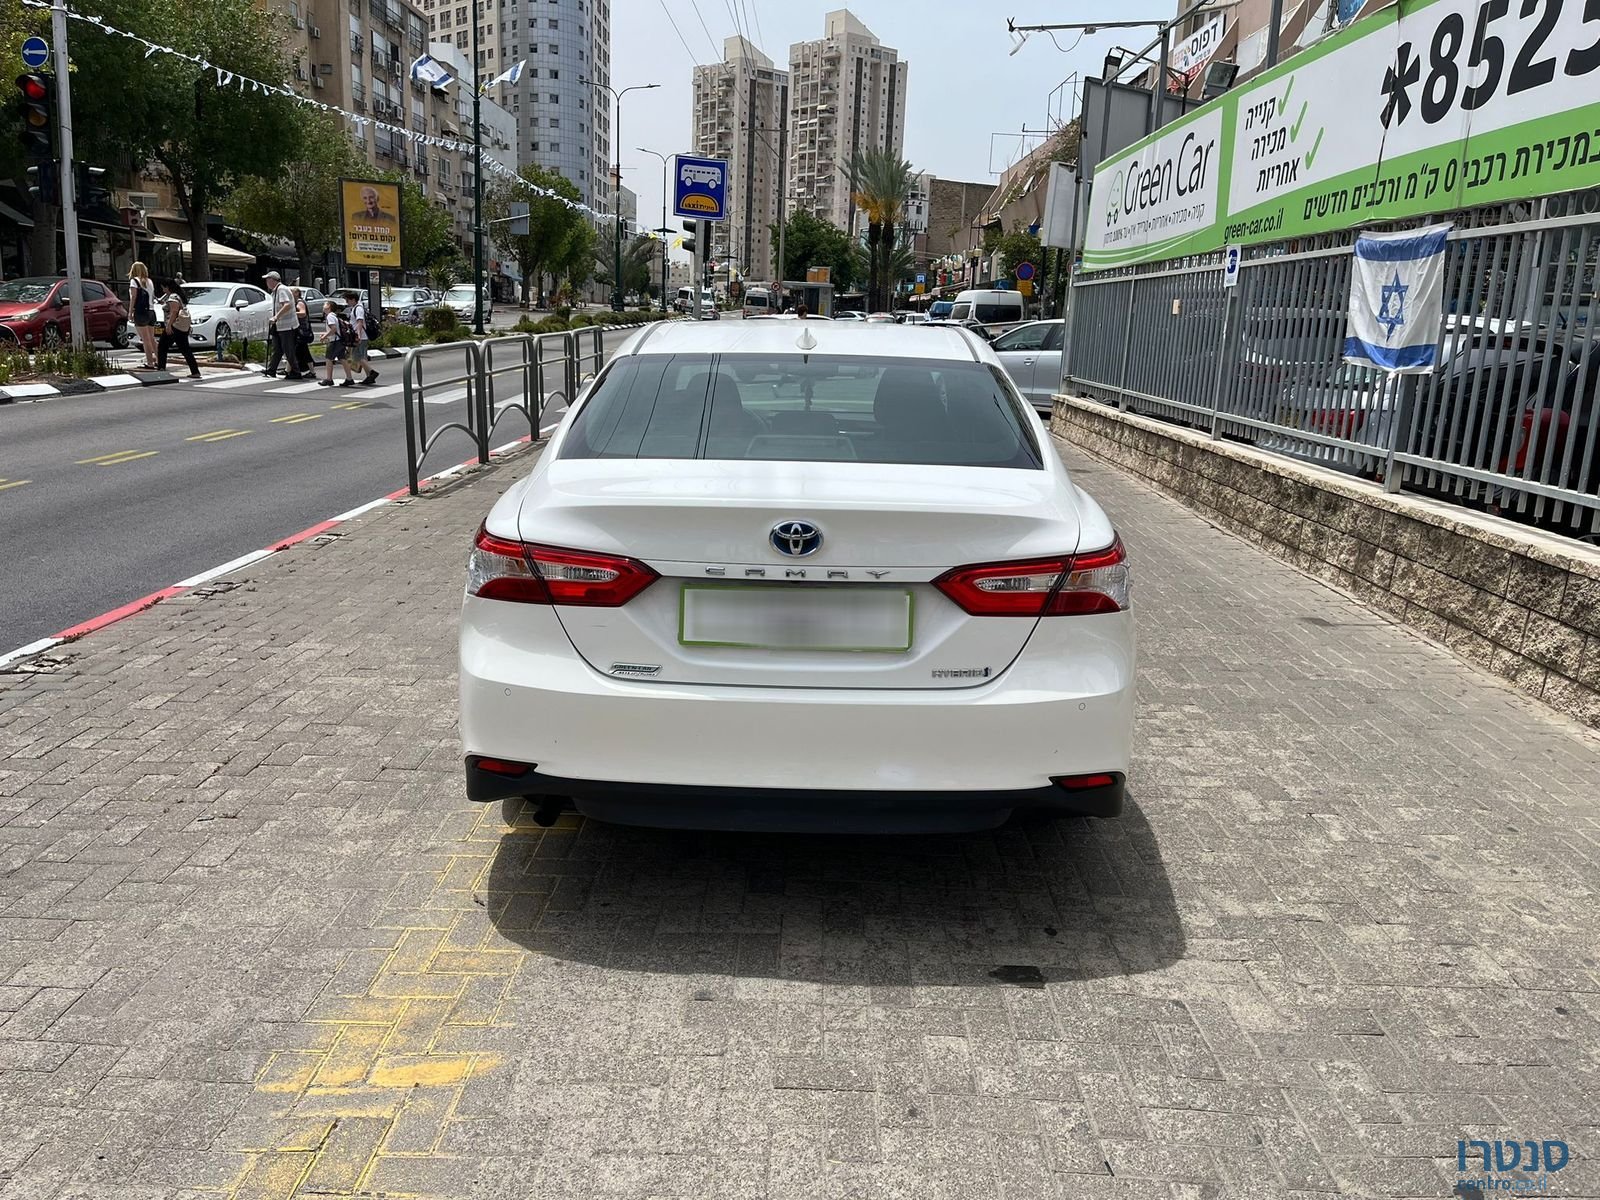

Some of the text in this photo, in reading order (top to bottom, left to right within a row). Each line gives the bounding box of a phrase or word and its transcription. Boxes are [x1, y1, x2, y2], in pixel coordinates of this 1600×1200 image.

[1190, 22, 1218, 56] דפוס
[1245, 97, 1276, 130] קנייה
[1251, 126, 1287, 161] מכירה
[1124, 131, 1215, 216] Green Car
[1256, 156, 1301, 192] אחריות
[1444, 157, 1458, 193] 0
[1463, 152, 1507, 188] רכבי
[1303, 189, 1348, 220] חדשים
[1351, 176, 1402, 209] ורכבים
[369, 233, 379, 241] גם
[381, 234, 395, 242] נקום
[1223, 207, 1284, 245] green-car.co.il
[705, 566, 891, 579] CAMRY
[931, 669, 983, 679] HYBRID
